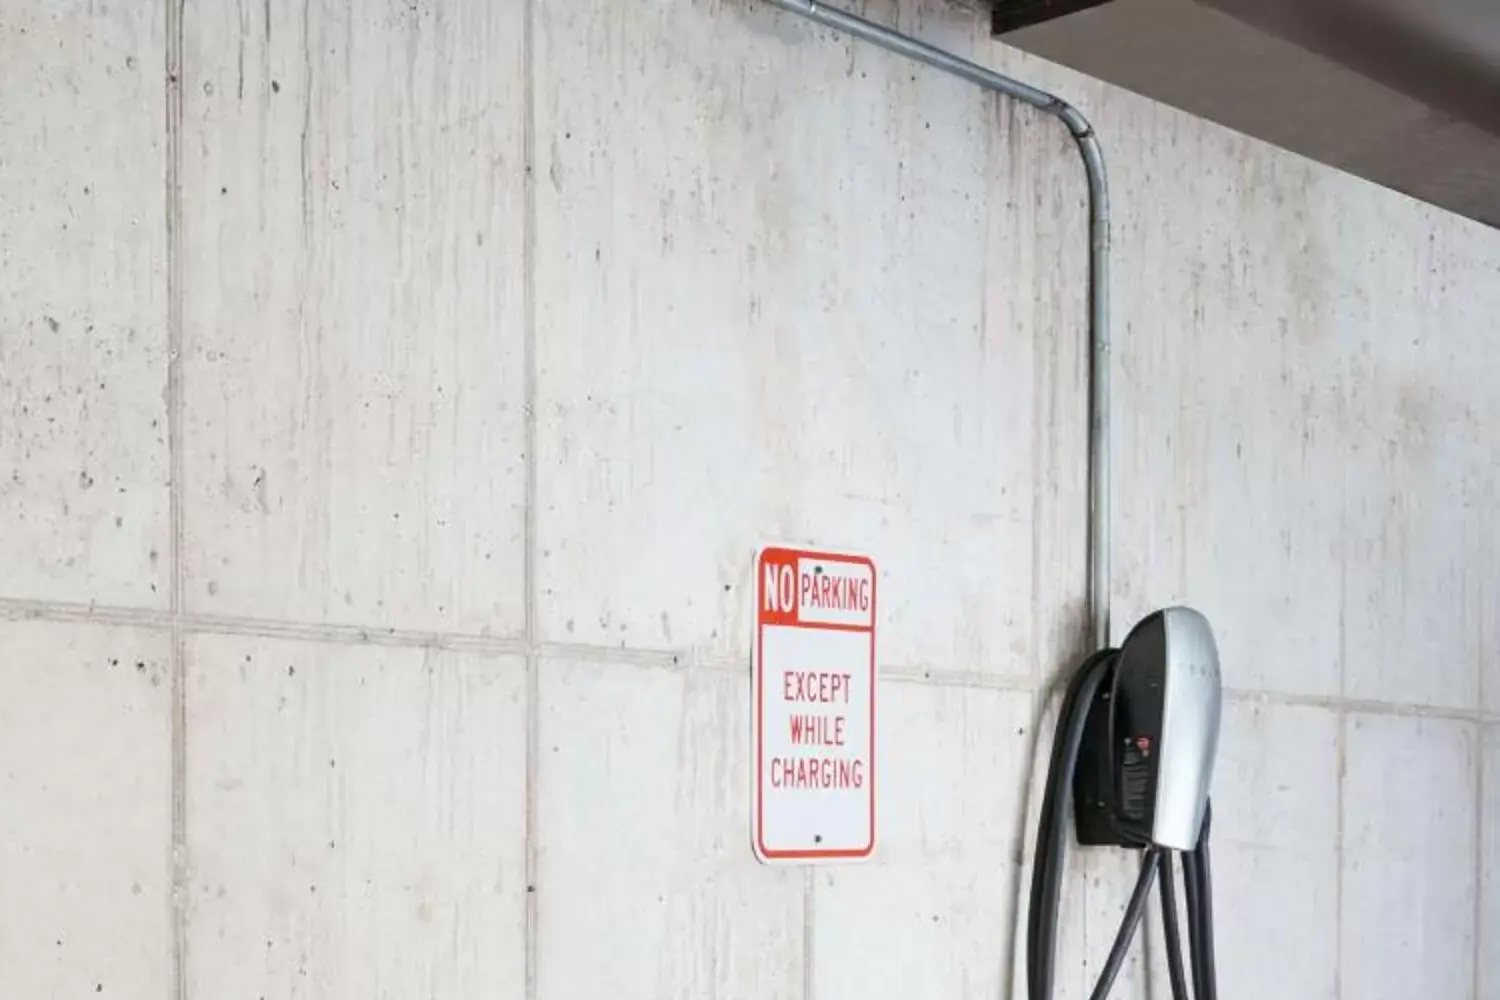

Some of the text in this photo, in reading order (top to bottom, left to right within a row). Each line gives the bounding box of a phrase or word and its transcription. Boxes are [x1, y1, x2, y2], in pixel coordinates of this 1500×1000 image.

[764, 562, 869, 613] NO PARKING
[783, 670, 851, 704] EXCEPT
[789, 714, 845, 746] WHILE
[771, 756, 863, 789] CHARGING
